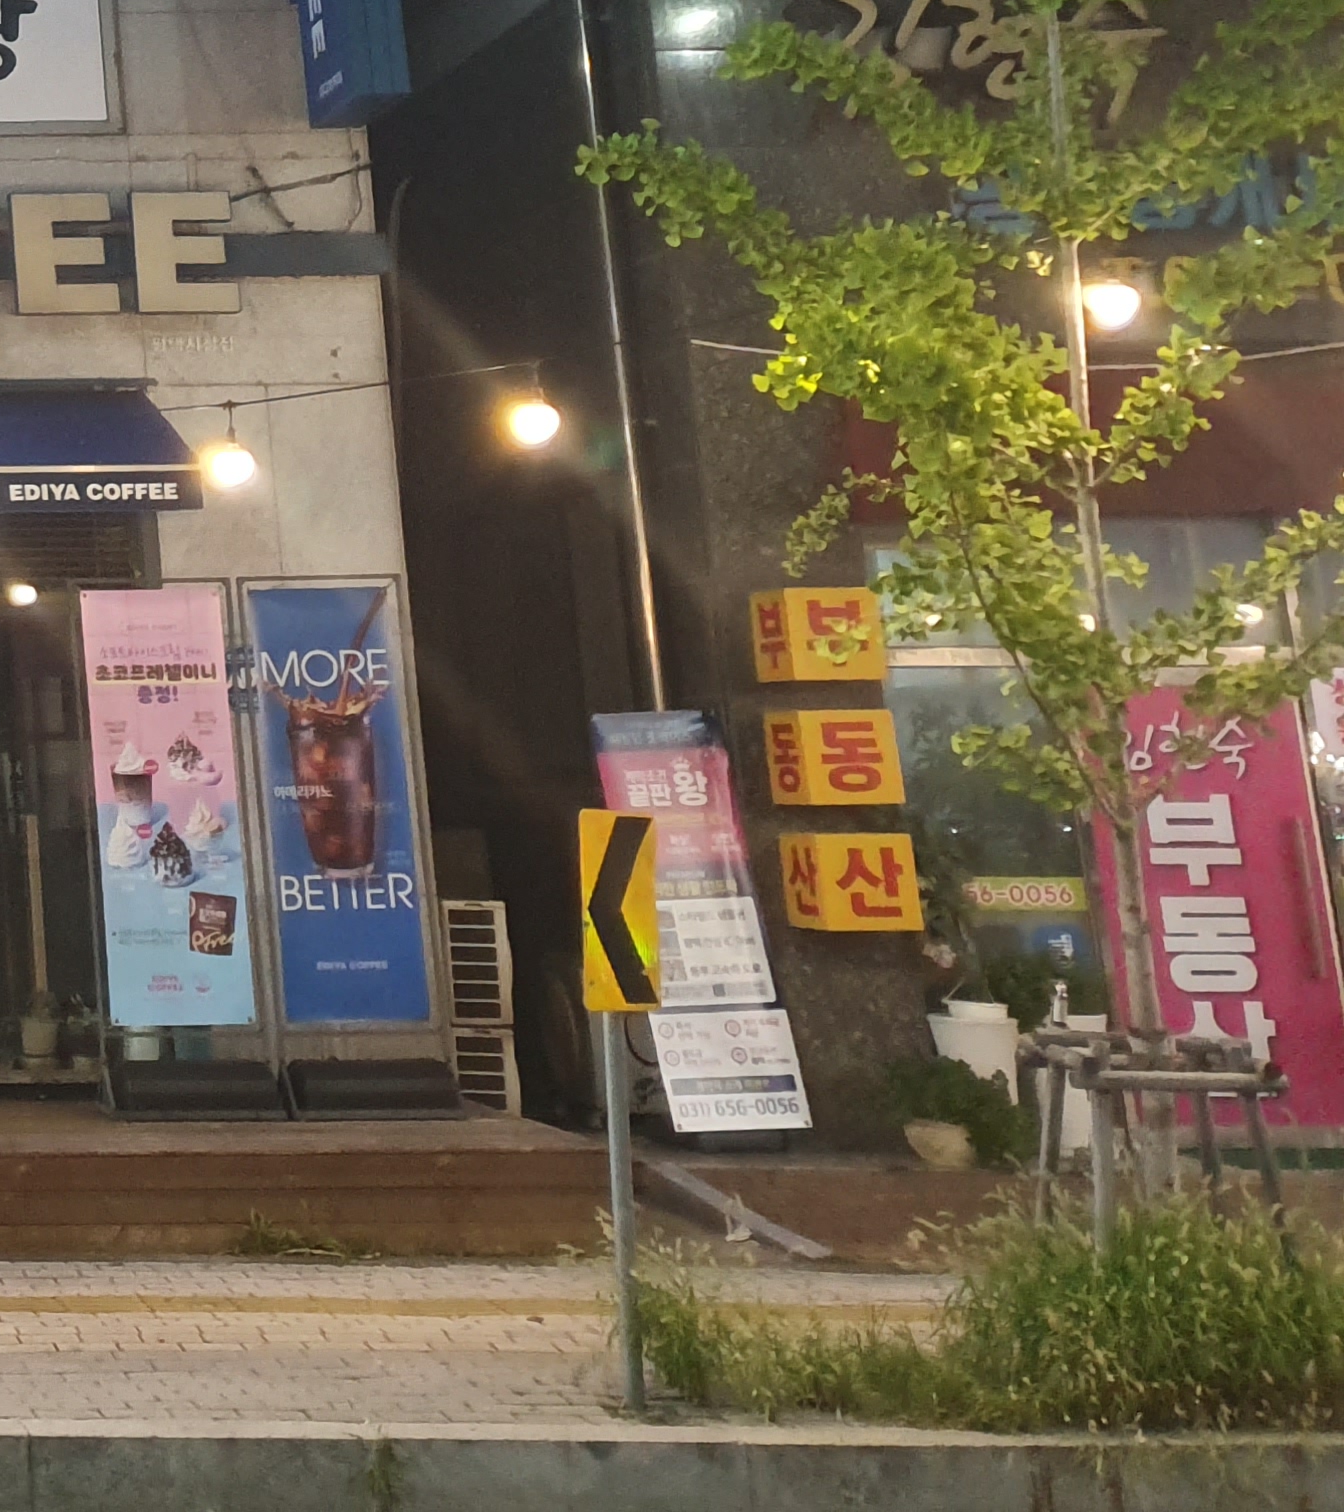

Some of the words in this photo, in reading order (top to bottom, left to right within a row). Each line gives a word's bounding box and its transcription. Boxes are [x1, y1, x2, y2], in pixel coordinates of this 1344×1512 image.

[8, 484, 80, 503] EDIYA
[85, 482, 179, 502] COFFEE
[260, 648, 393, 688] MORE
[279, 871, 415, 912] BETTER
[714, 1096, 801, 1117] 656-0056
